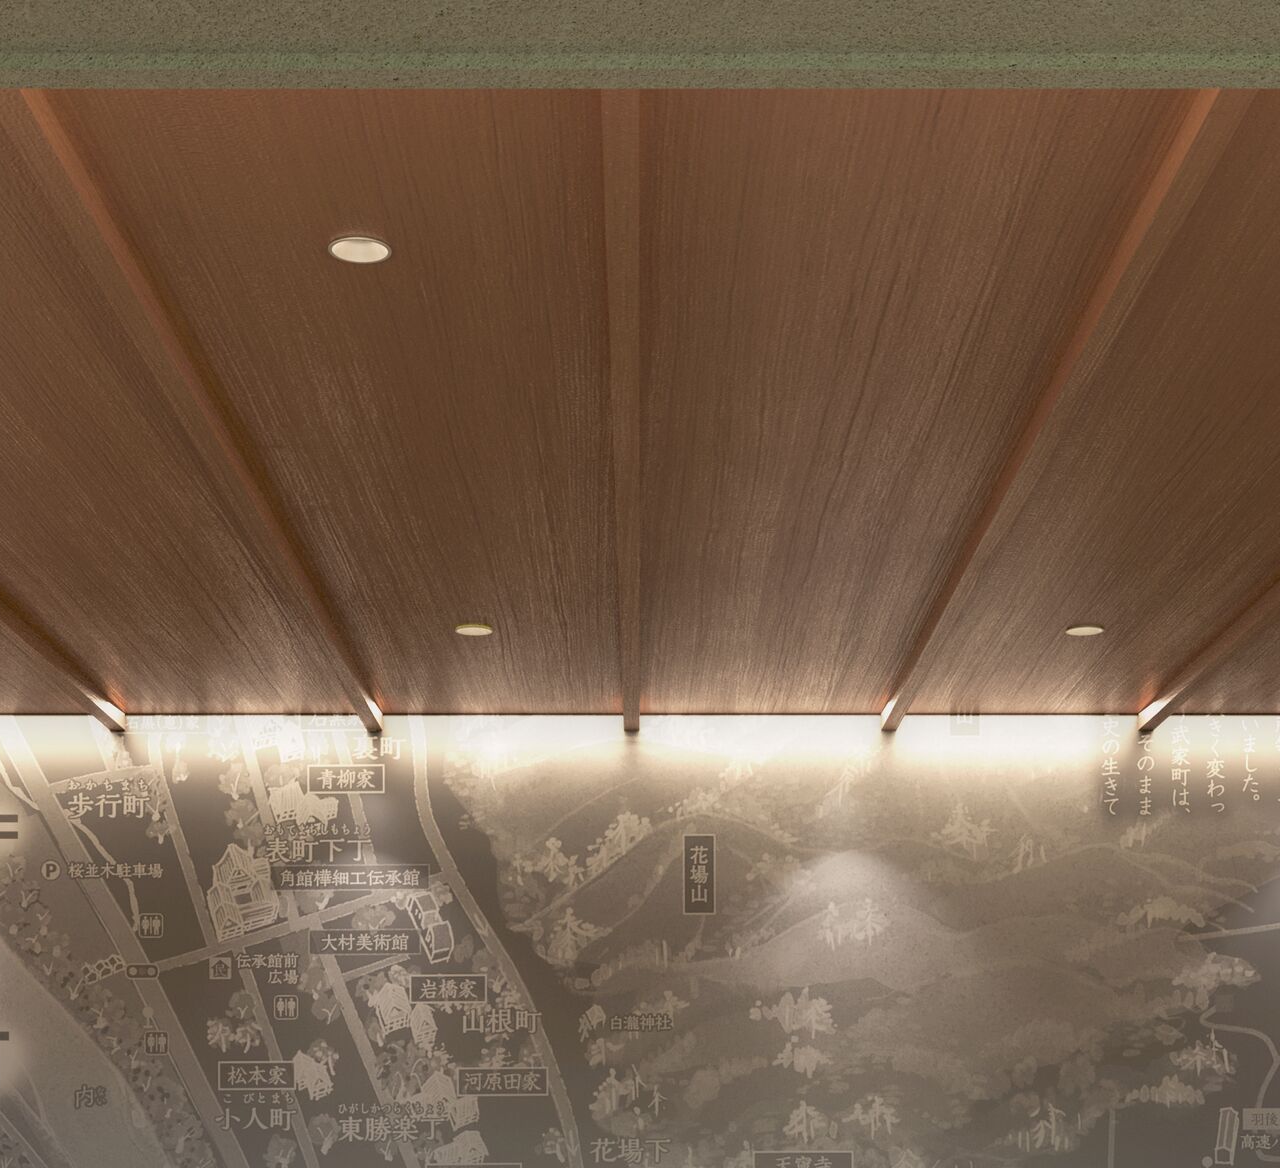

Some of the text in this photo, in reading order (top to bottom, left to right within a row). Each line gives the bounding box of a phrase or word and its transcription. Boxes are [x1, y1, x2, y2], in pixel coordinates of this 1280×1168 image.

[1101, 717, 1120, 815] 史の生きて
[1171, 714, 1191, 813] 武家町は、
[1206, 714, 1226, 813] きく変わっ
[1241, 718, 1260, 801] いました。
[68, 778, 150, 791] おかちまち
[319, 769, 376, 789] 青柳家
[1137, 734, 1154, 815] そのまま
[68, 794, 150, 818] 歩行町
[266, 838, 371, 862] 表町下丁
[68, 862, 164, 880] 桜並木駐車場
[280, 869, 421, 888] 角館樺細工伝承館
[690, 845, 708, 903] 花場山
[321, 933, 409, 951] 大村美術館
[236, 954, 298, 969] 伝承館前
[267, 969, 299, 985] 広場
[419, 980, 478, 999] 岩橋家
[462, 1009, 542, 1034] 山根町
[227, 1066, 288, 1085] 松本家
[464, 1073, 541, 1091] 河原田家
[222, 1092, 297, 1104] こびとまち
[215, 1107, 297, 1131] 小人町
[338, 1116, 446, 1142] 東勝楽丁
[590, 1137, 672, 1163] 花場下
